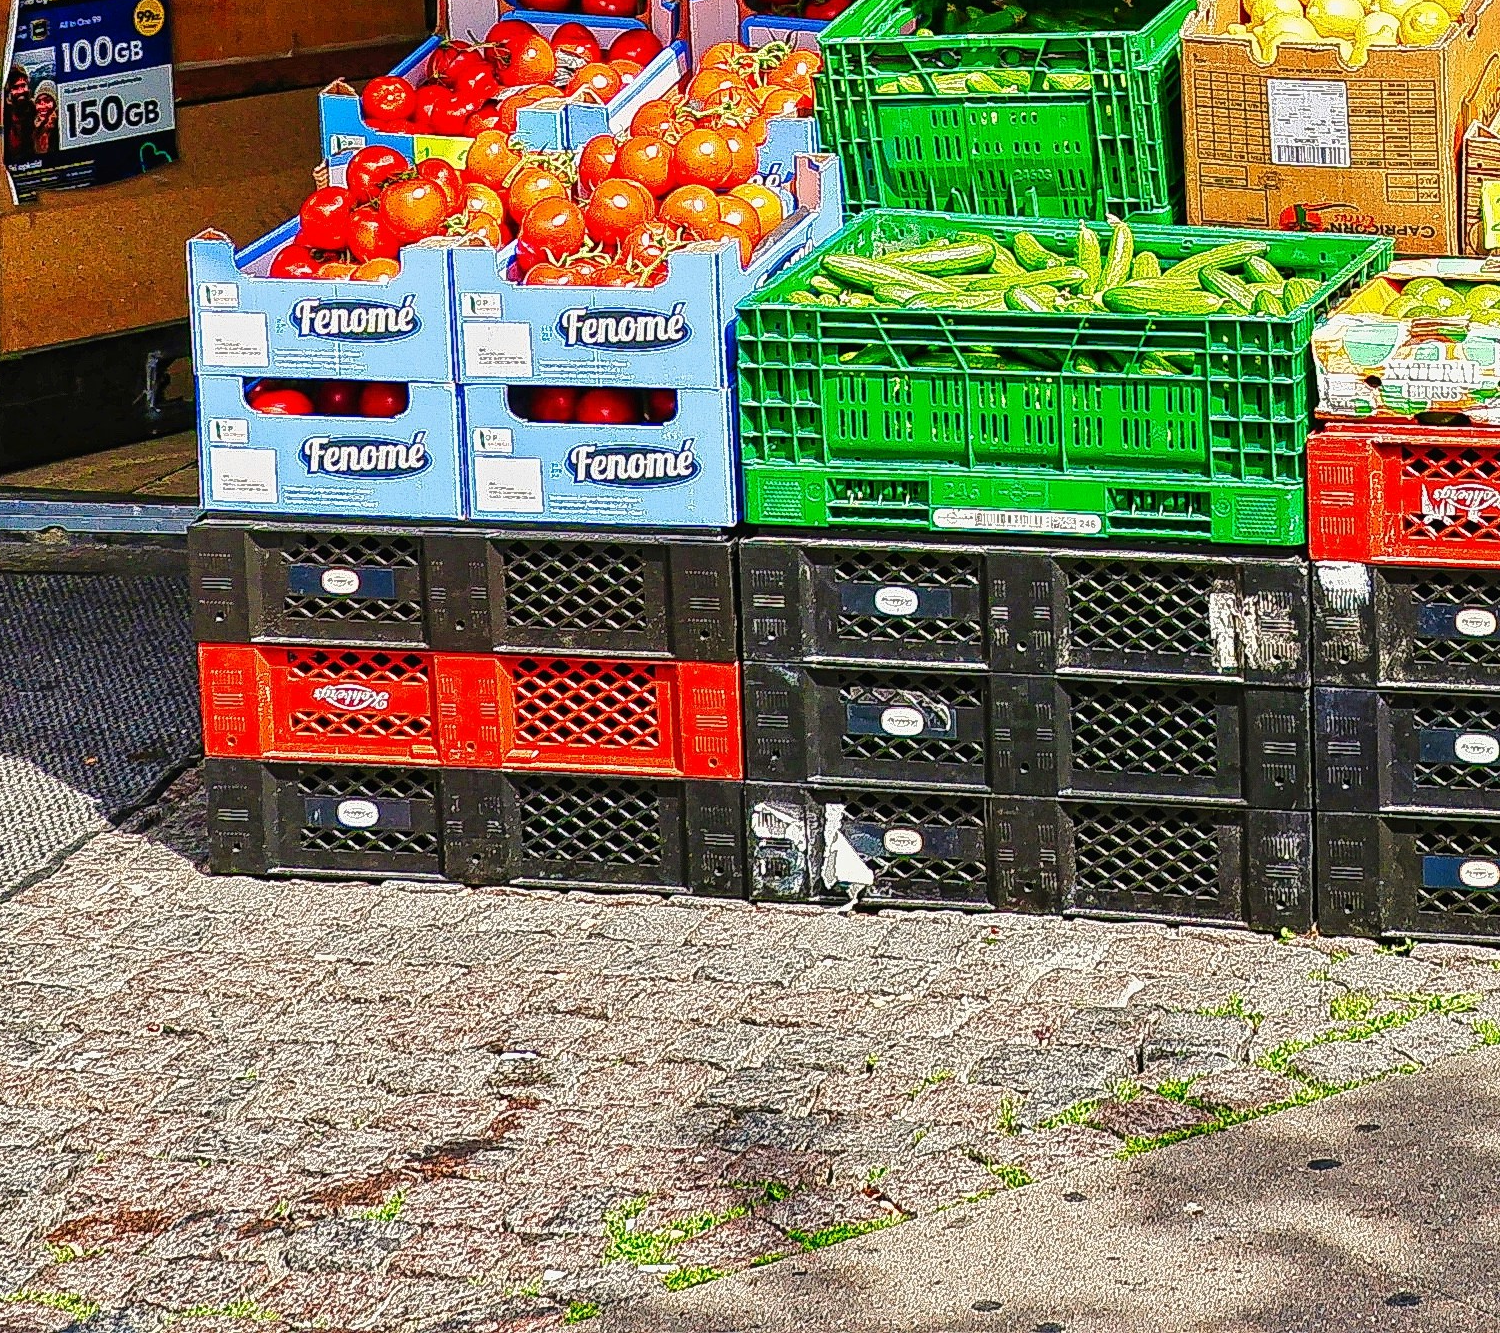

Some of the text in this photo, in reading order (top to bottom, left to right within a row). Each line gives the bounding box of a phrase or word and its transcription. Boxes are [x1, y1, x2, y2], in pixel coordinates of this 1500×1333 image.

[60, 35, 144, 73] 100GB
[65, 94, 161, 140] 150GB
[1326, 220, 1436, 239] CAPRICORN
[296, 291, 417, 337] Fenomé
[561, 303, 687, 348] Fenomé
[1385, 360, 1482, 385] NATURAL
[1405, 383, 1459, 400] CITRUS
[302, 433, 426, 478] Fenomé
[570, 439, 695, 485] Fenomé
[1077, 519, 1097, 530] 246
